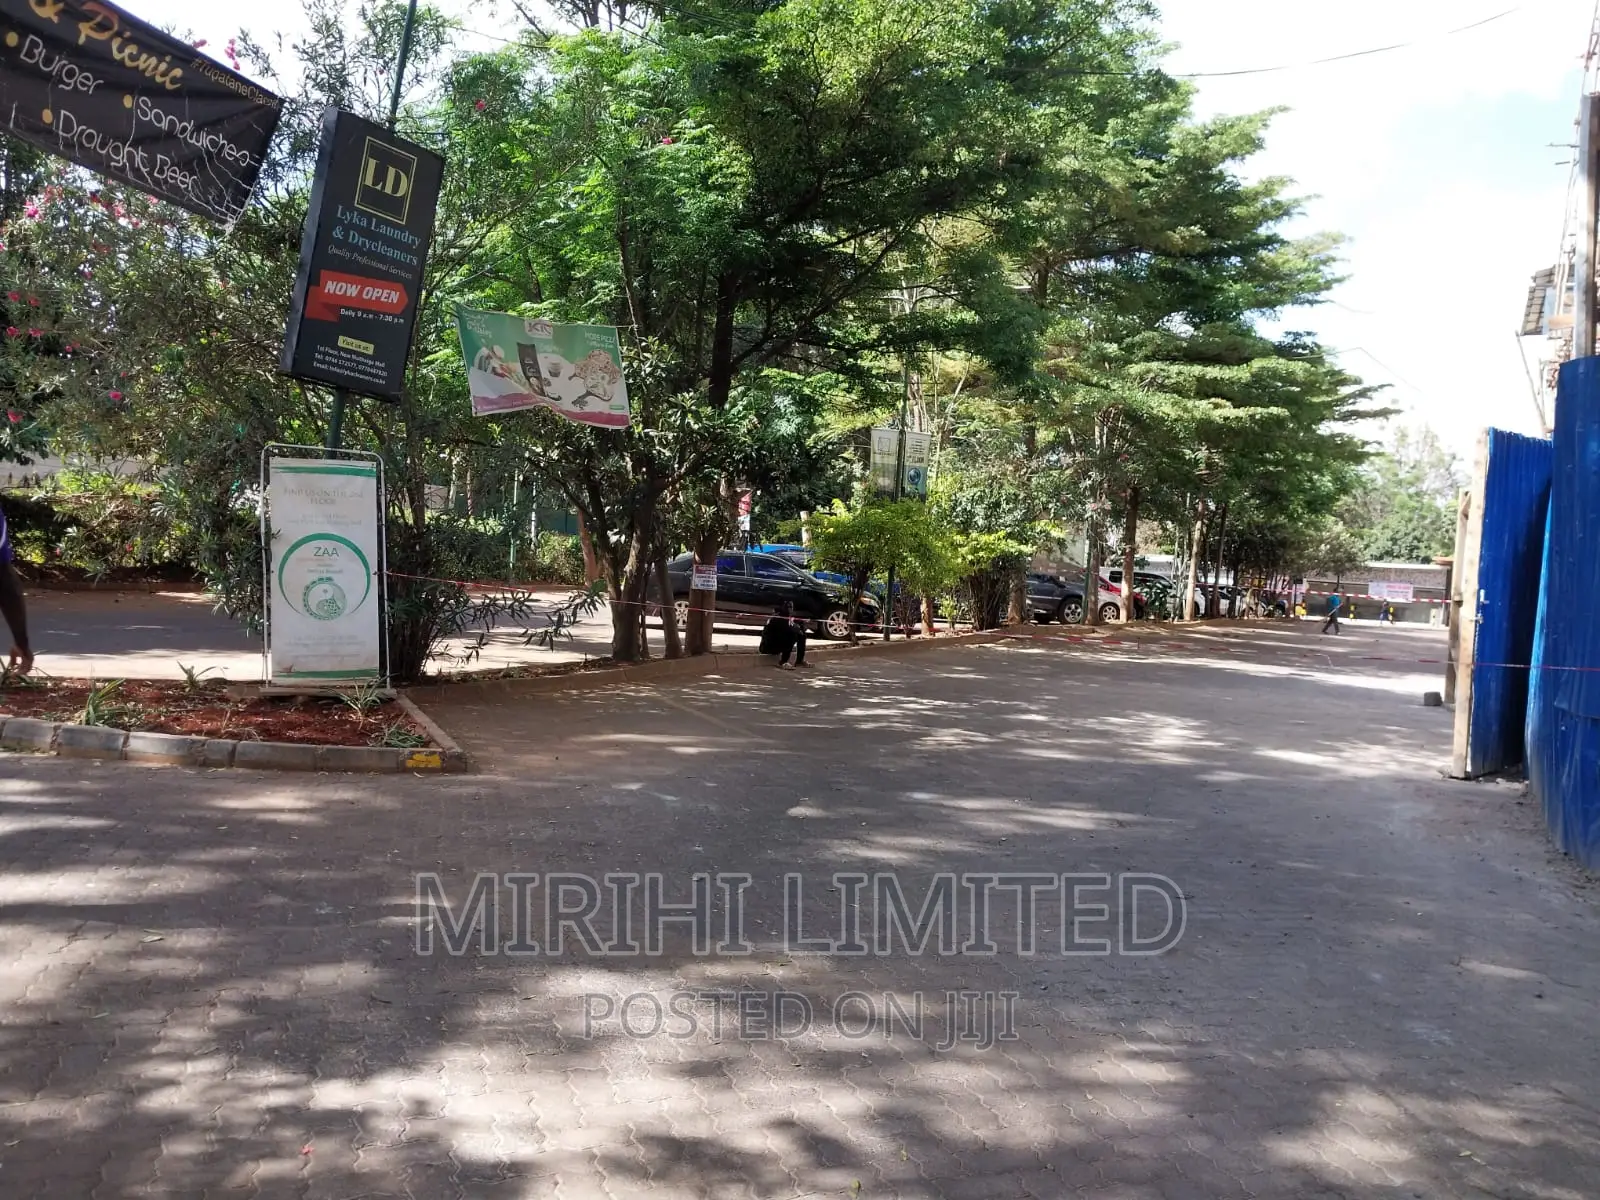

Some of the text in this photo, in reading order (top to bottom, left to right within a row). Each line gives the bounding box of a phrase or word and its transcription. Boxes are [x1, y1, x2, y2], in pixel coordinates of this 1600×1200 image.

[20, 34, 104, 95] Burger
[79, 2, 183, 90] Picnic
[59, 110, 199, 190] Draught Beer
[137, 96, 249, 167] Sandwiches
[363, 156, 408, 198] LD
[332, 225, 418, 266] & Drycleaners
[336, 205, 421, 249] Lyka Laundry
[328, 244, 412, 279] Quality Professional Services
[324, 280, 400, 304] NOW OPEN
[340, 308, 356, 318] Daily
[313, 546, 340, 557] ZAA
